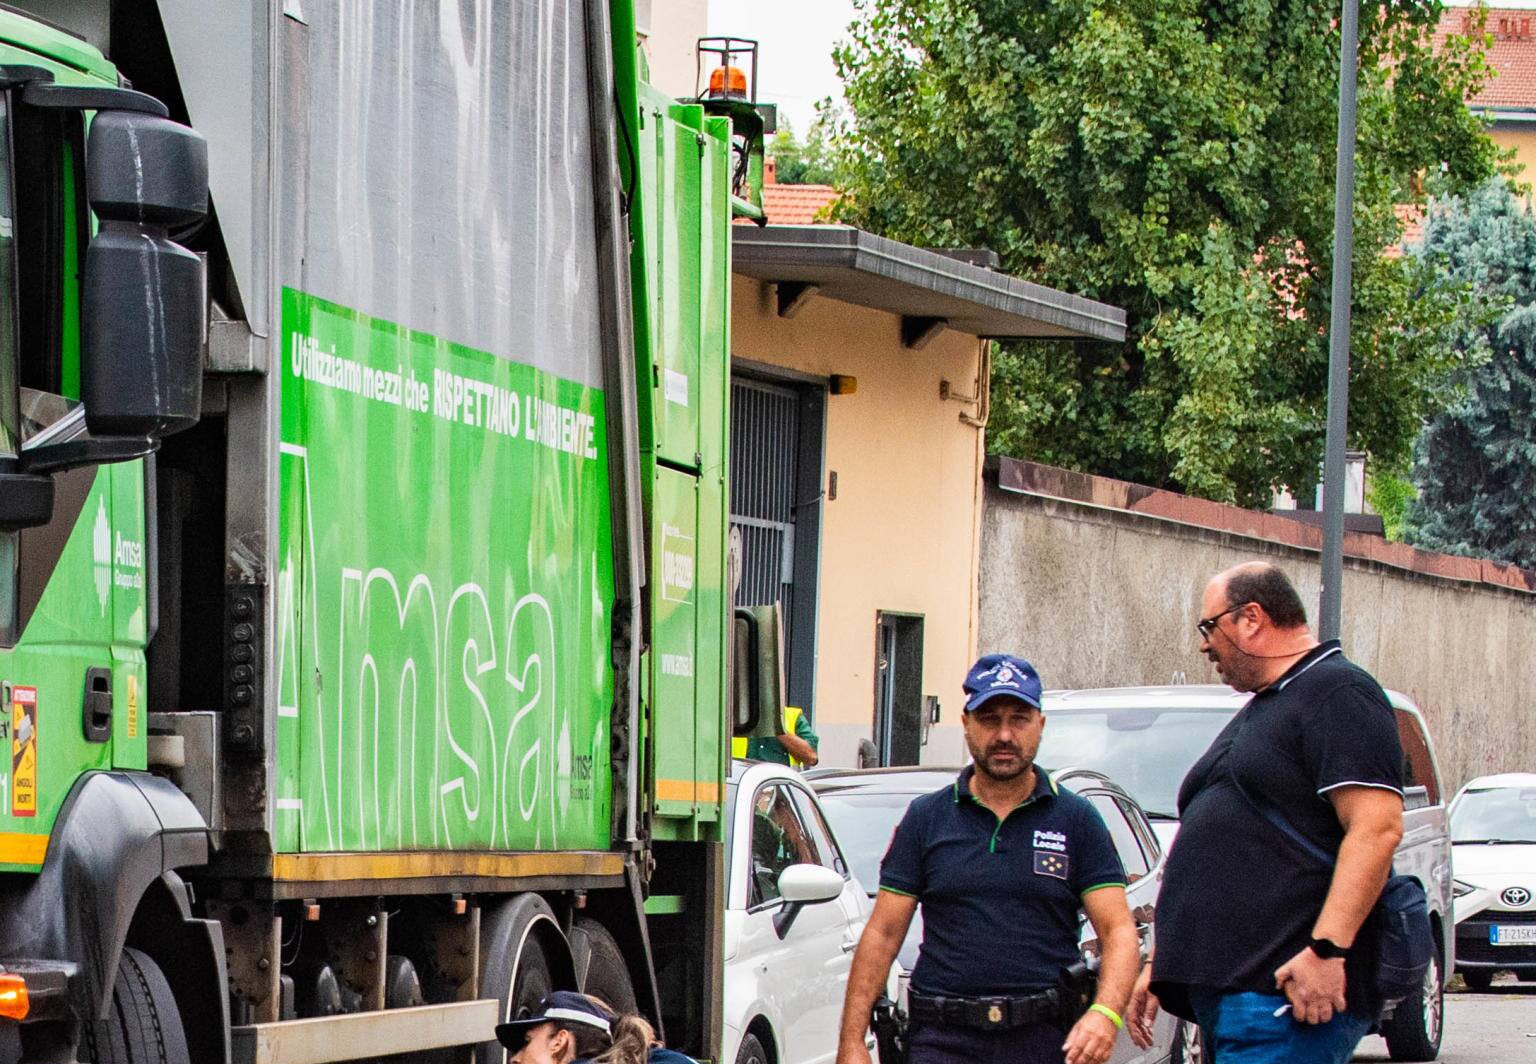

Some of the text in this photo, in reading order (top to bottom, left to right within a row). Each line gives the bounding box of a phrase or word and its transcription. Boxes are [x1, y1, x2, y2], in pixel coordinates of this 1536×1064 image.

[291, 331, 361, 394] Utilizziamo
[363, 364, 402, 406] mezzi
[404, 369, 429, 413] che
[434, 368, 520, 438] RISPETTANO
[114, 530, 142, 568] Amsa
[1033, 838, 1066, 851] Locale
[1034, 830, 1066, 842] Polizia
